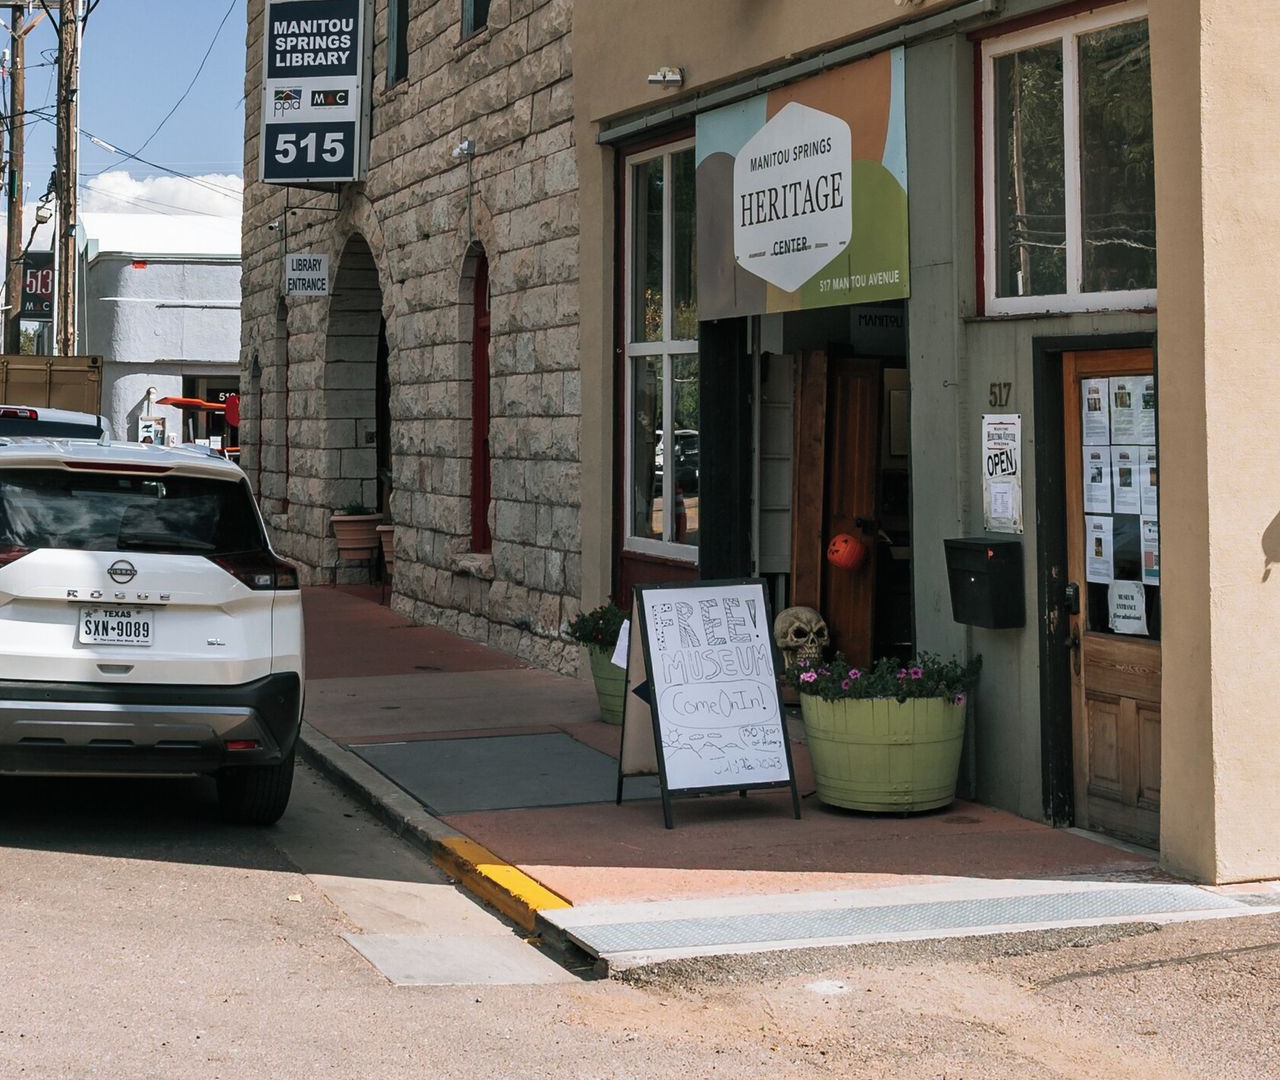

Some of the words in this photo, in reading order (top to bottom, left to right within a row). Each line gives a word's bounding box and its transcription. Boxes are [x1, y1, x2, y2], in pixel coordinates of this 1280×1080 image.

[273, 18, 354, 35] MANITOU
[275, 35, 351, 51] SPRINGS
[275, 51, 350, 67] LIBRARY
[274, 132, 345, 164] 515
[750, 148, 790, 173] MANITOU
[793, 137, 832, 162] SPRINGS
[740, 172, 844, 227] HERITAGE
[773, 236, 808, 256] CENTER
[291, 258, 322, 272] LIBRARY
[26, 269, 53, 294] 513
[287, 278, 326, 291] ENTRANCE
[820, 279, 830, 293] 517
[832, 274, 867, 291] MANTOU
[868, 270, 900, 286] AVENUE
[988, 382, 1012, 407] 517
[987, 449, 1014, 477] OPEN
[103, 610, 131, 618] TEXAS
[660, 643, 772, 684] MUSEUM
